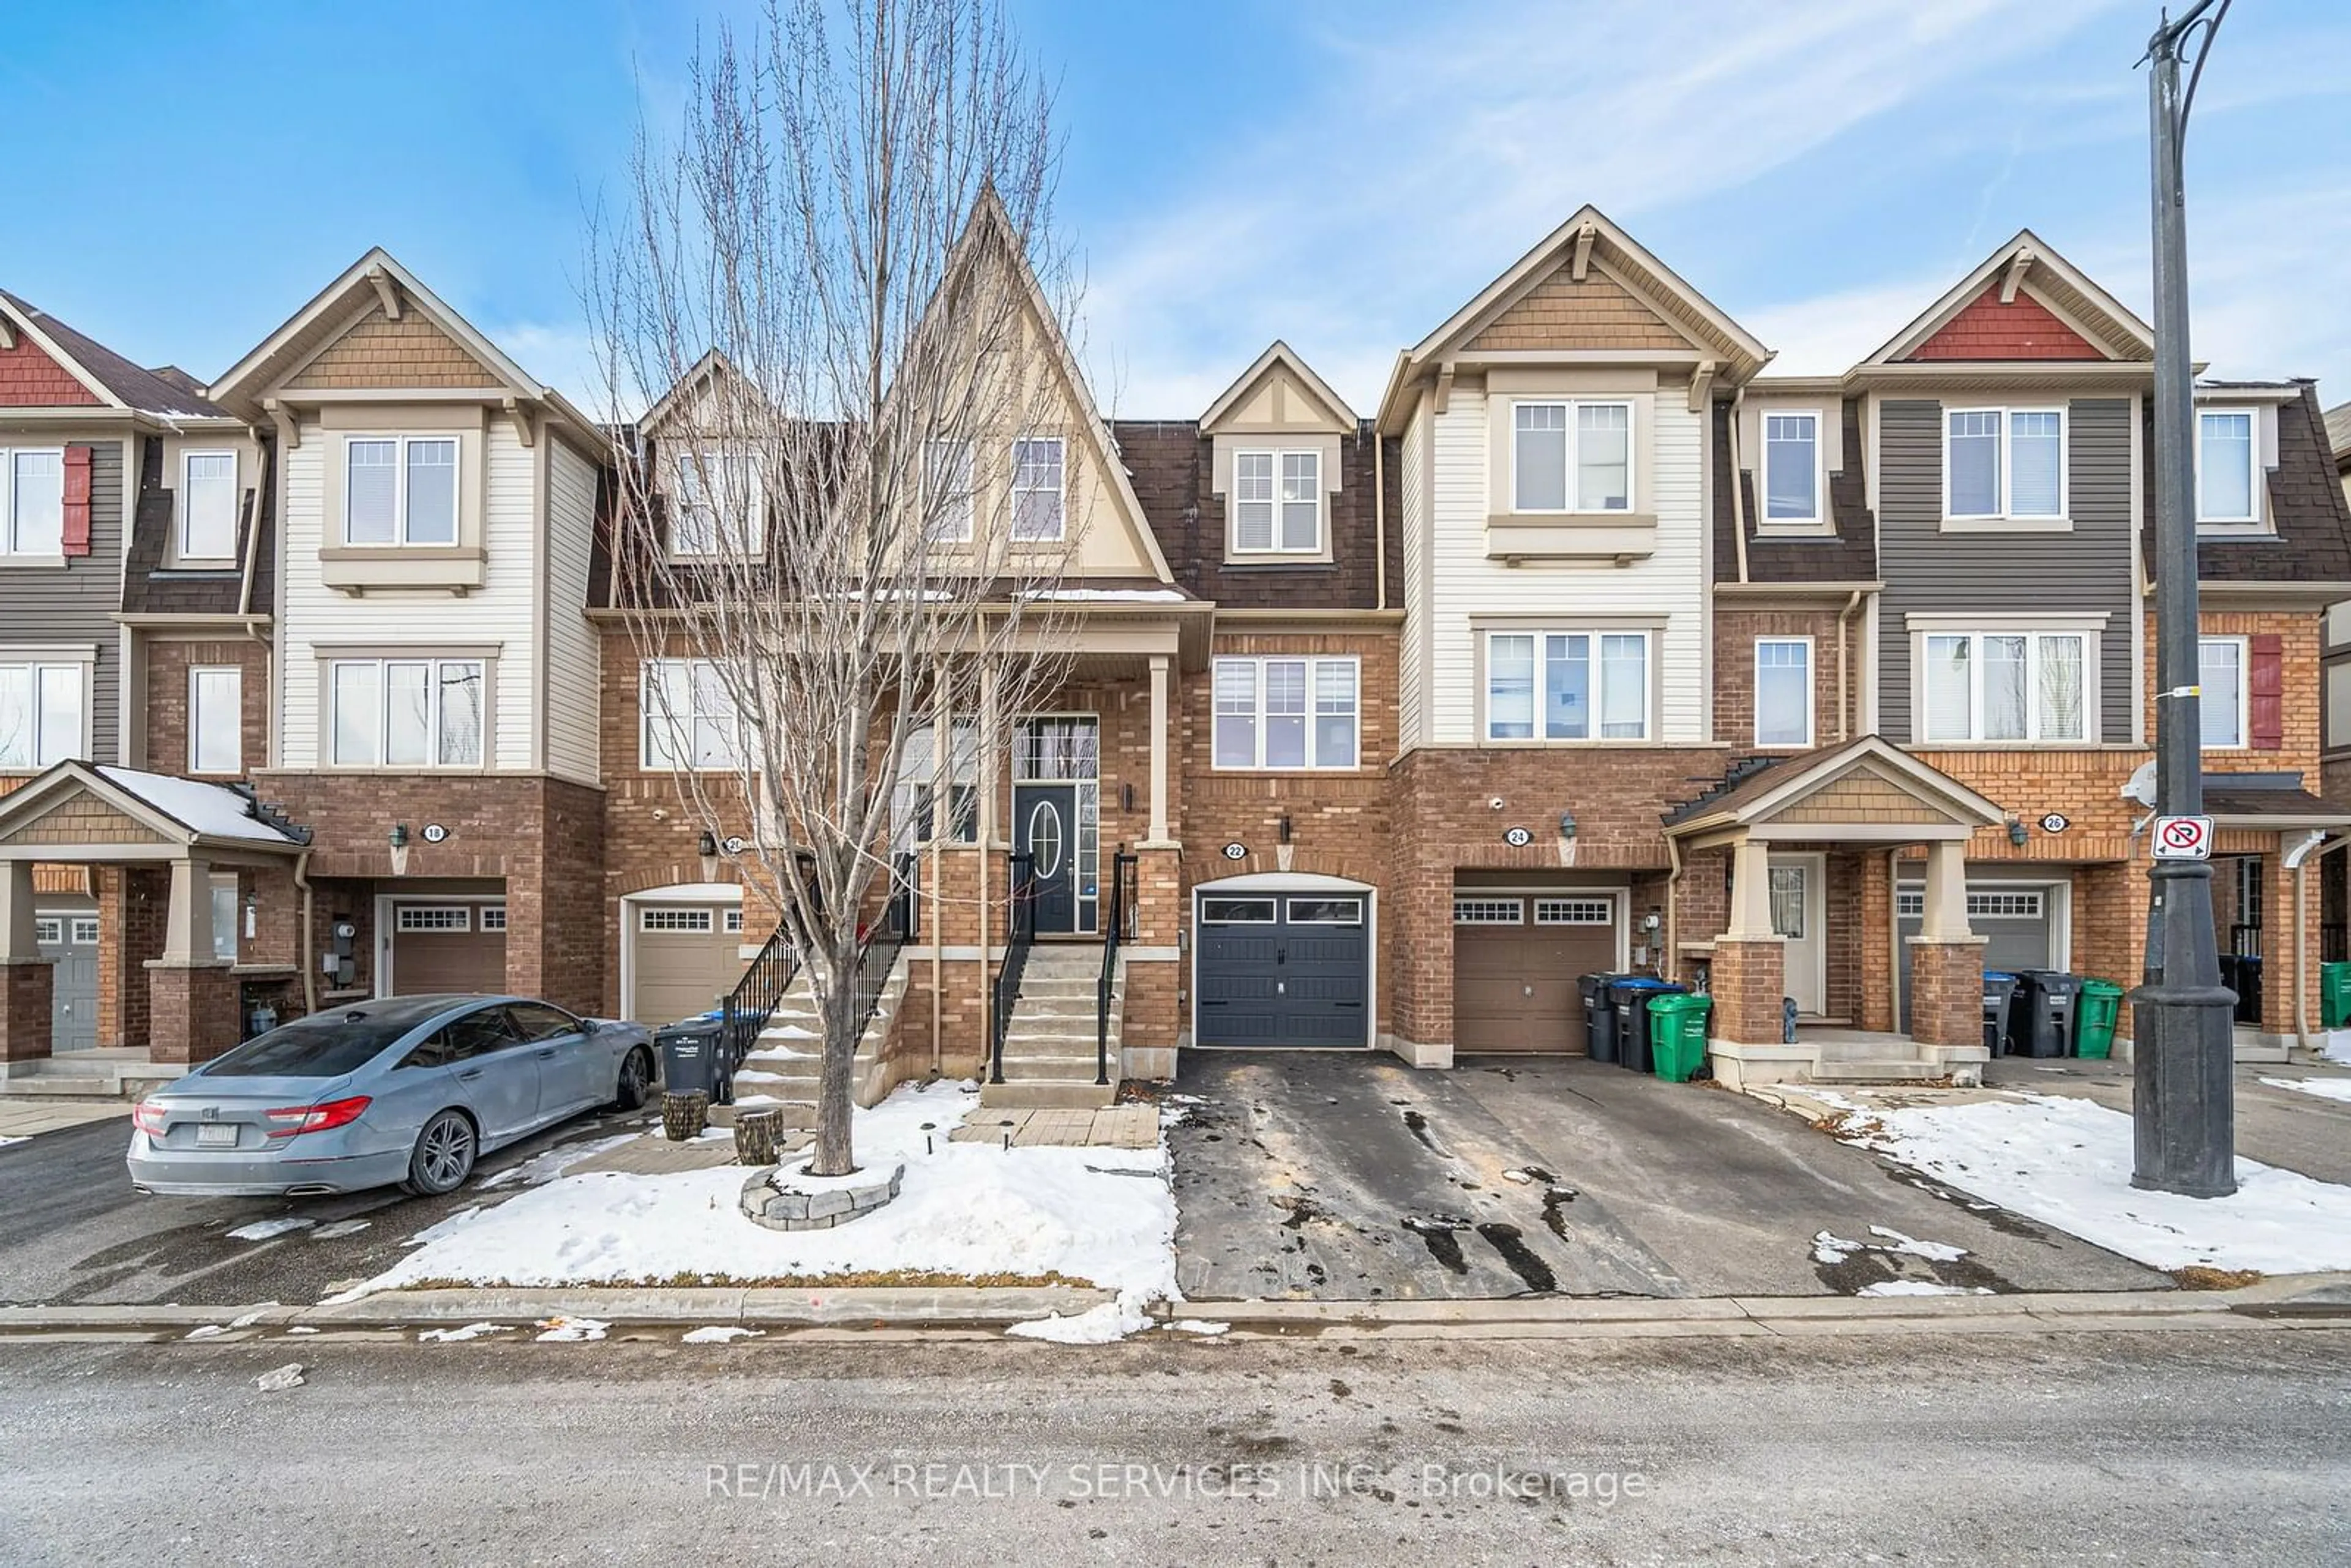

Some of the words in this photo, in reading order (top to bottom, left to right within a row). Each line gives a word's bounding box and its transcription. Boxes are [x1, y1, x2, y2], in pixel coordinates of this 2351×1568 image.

[2048, 818, 2061, 828] 26
[429, 828, 440, 838] 18
[1512, 832, 1524, 842] 24
[1229, 847, 1241, 856] 22
